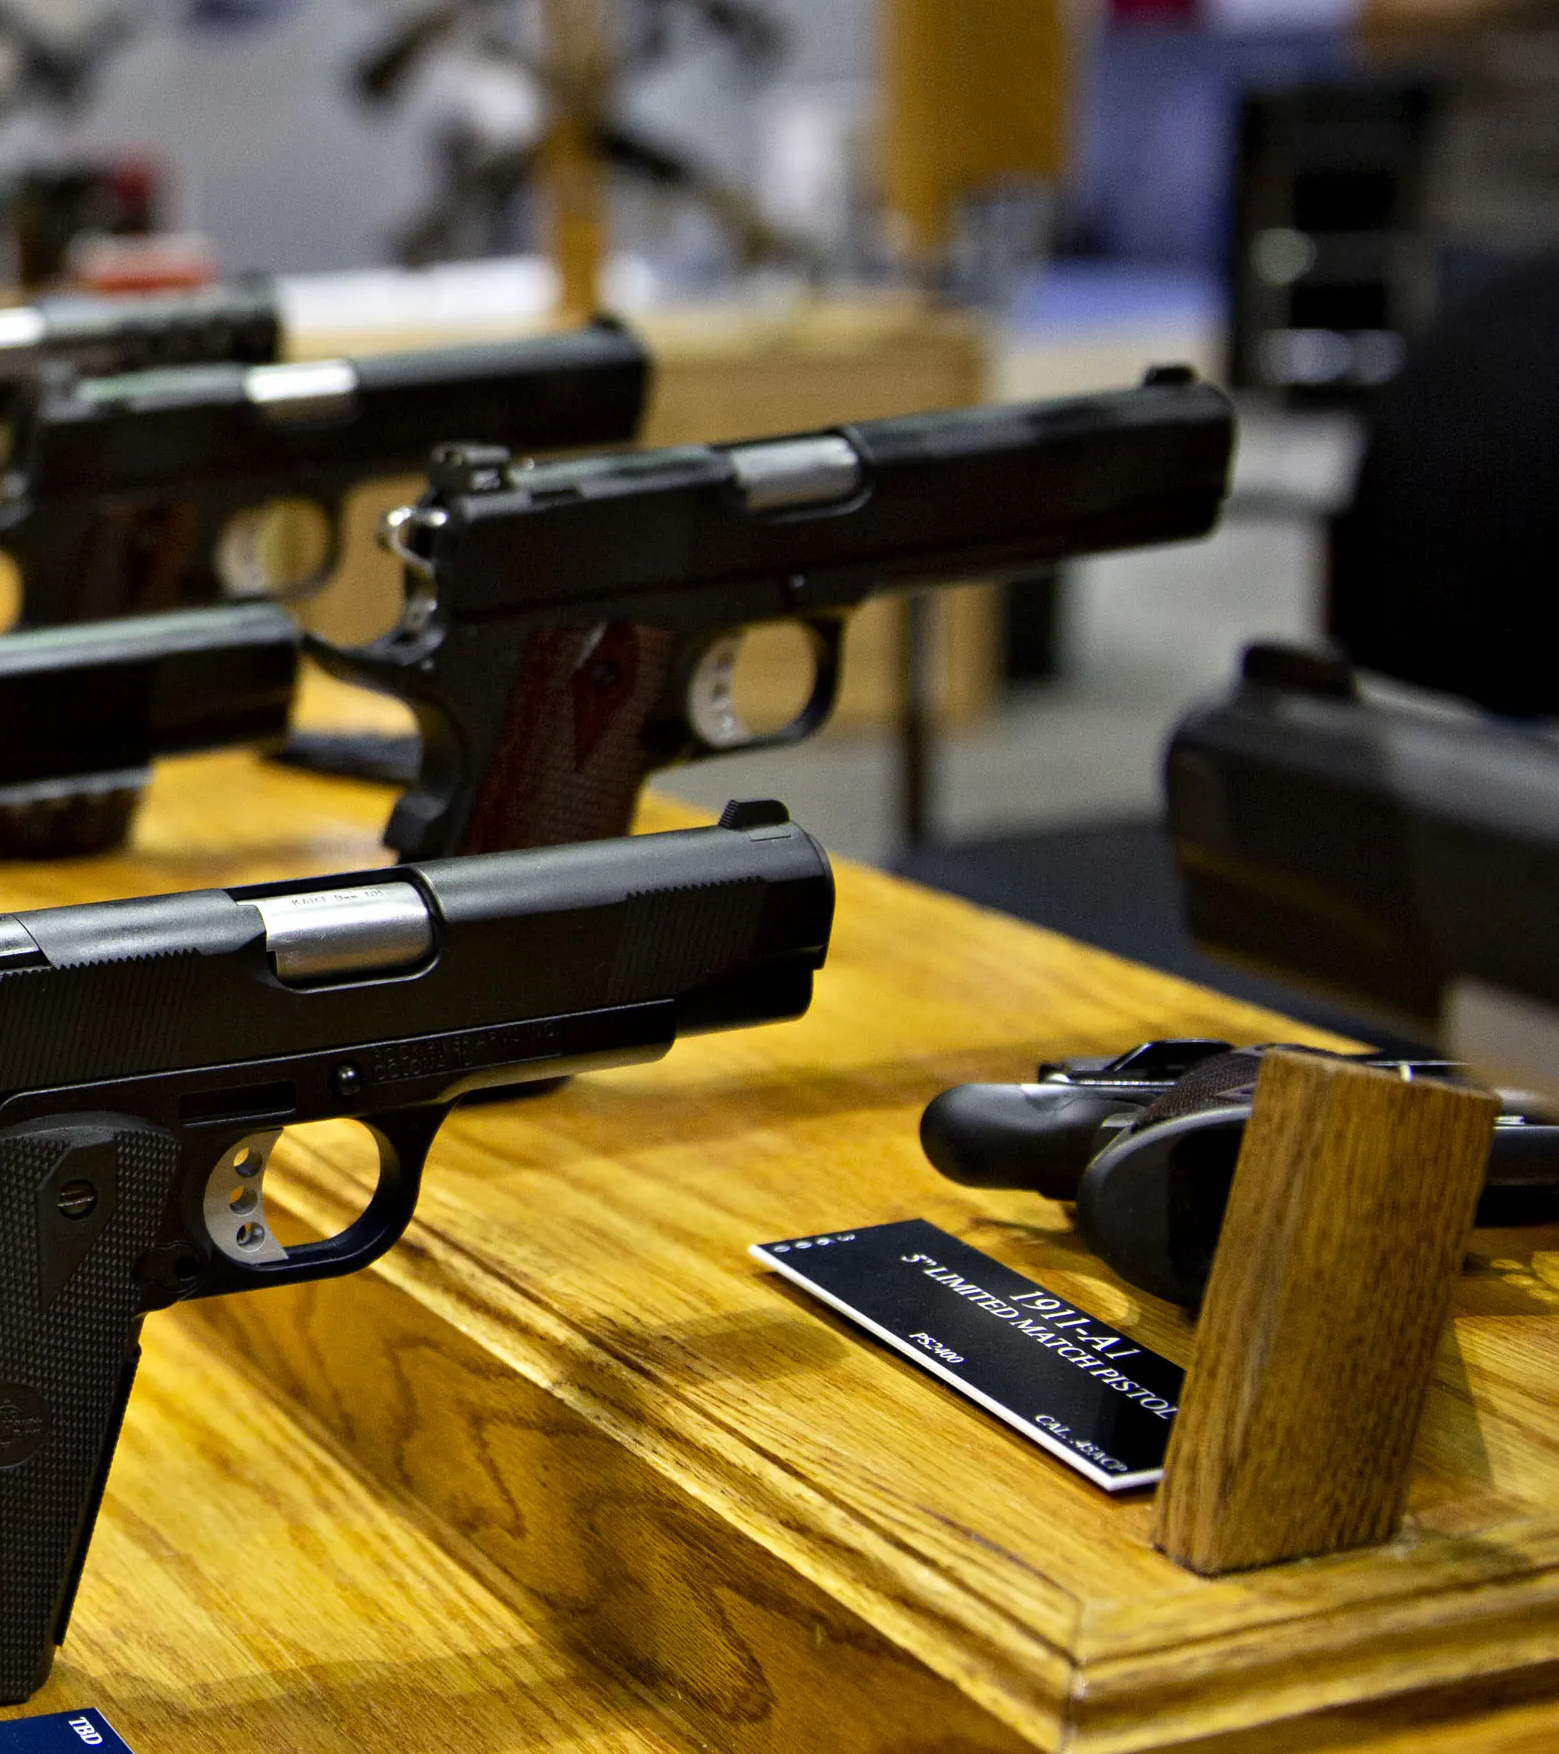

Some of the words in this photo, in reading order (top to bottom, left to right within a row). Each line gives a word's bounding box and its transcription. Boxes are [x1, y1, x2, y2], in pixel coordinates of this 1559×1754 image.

[908, 1332, 965, 1363] PS2400
[923, 1266, 1020, 1319] LIMITED
[1009, 1318, 1105, 1370] MATCH
[1089, 1368, 1179, 1420] PISTOL
[1009, 1290, 1142, 1360] 1911-A1
[68, 1716, 103, 1745] TBD
